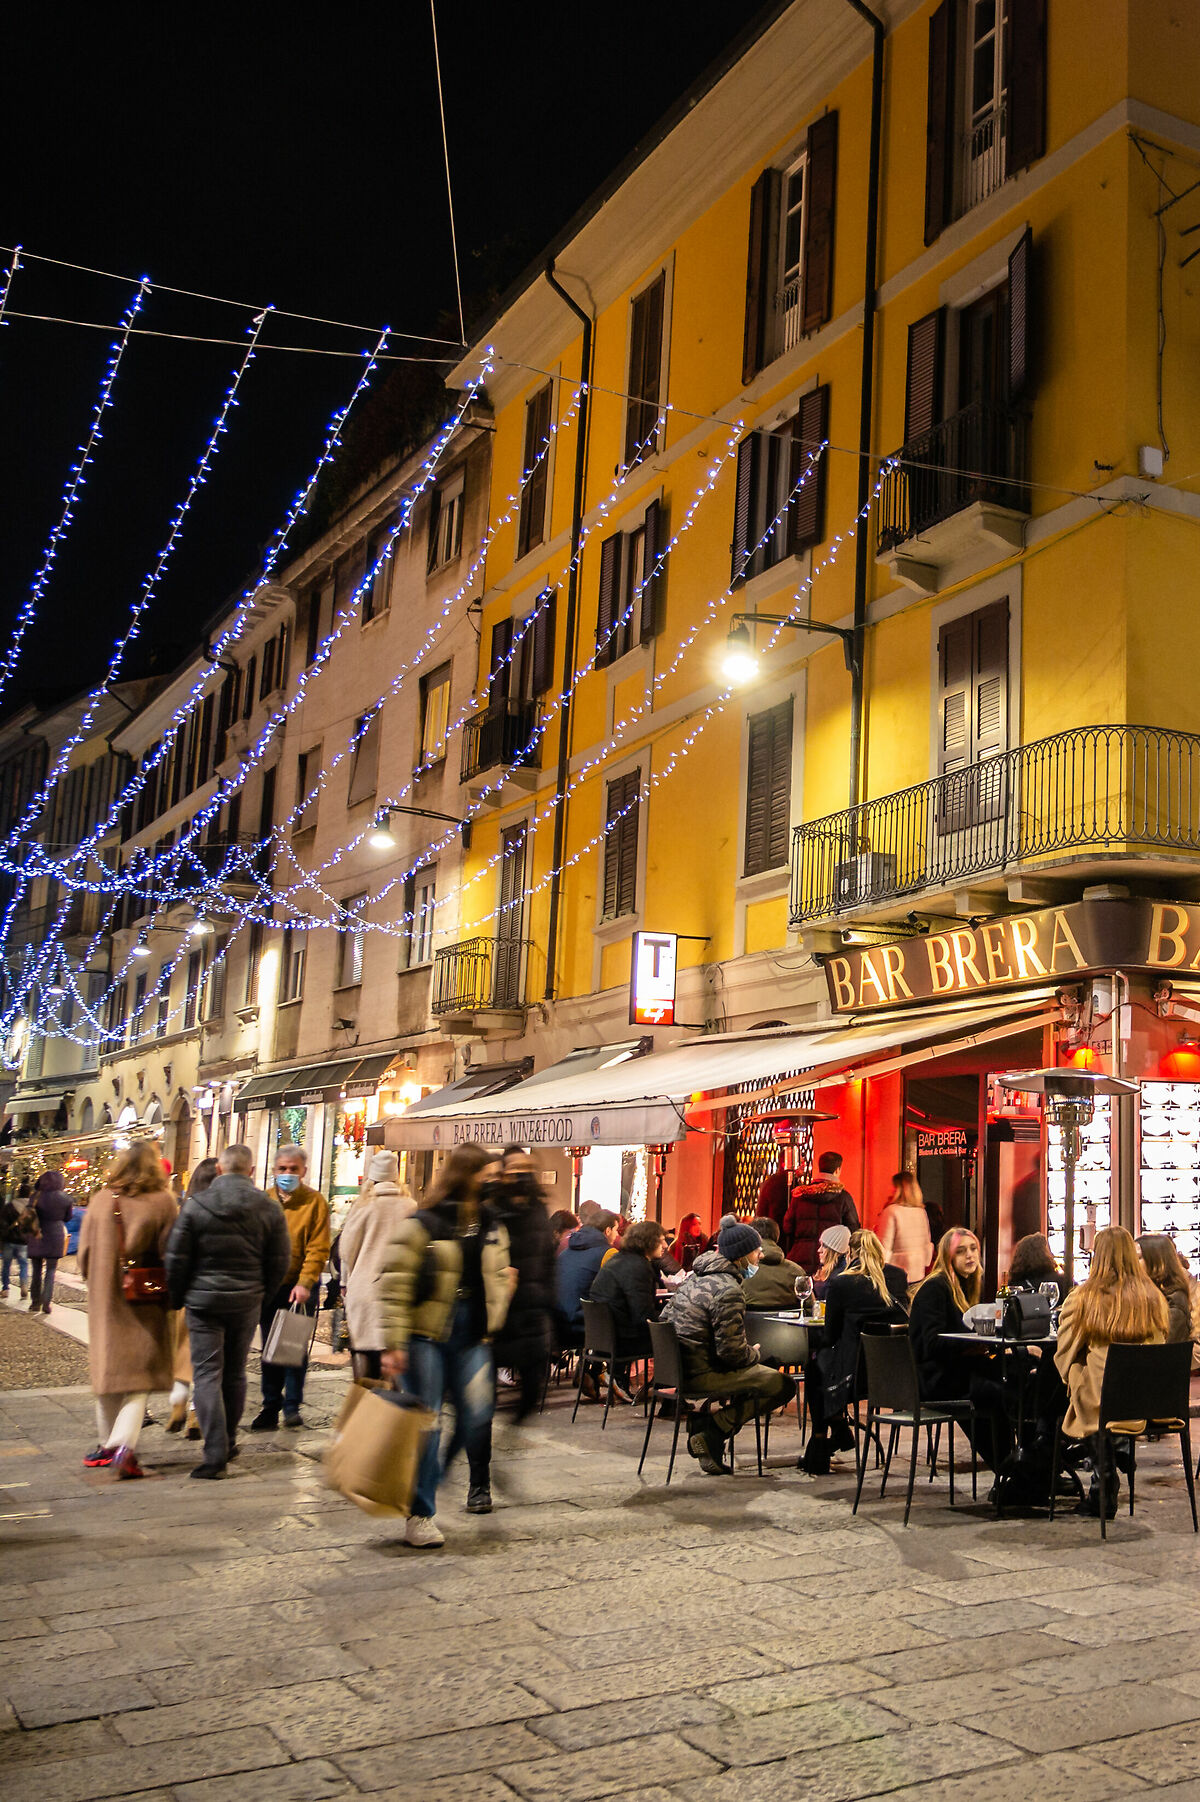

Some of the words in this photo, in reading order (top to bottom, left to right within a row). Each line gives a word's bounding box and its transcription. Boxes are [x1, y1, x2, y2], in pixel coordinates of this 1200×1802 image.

[643, 938, 671, 978] T
[829, 945, 914, 1010] BAR
[925, 910, 1088, 994] BRERA
[453, 1124, 471, 1145] BAR
[474, 1121, 504, 1144] BRERA
[510, 1118, 573, 1143] WINE&FOOD
[918, 1133, 936, 1147] BAR
[937, 1131, 967, 1145] BRERA
